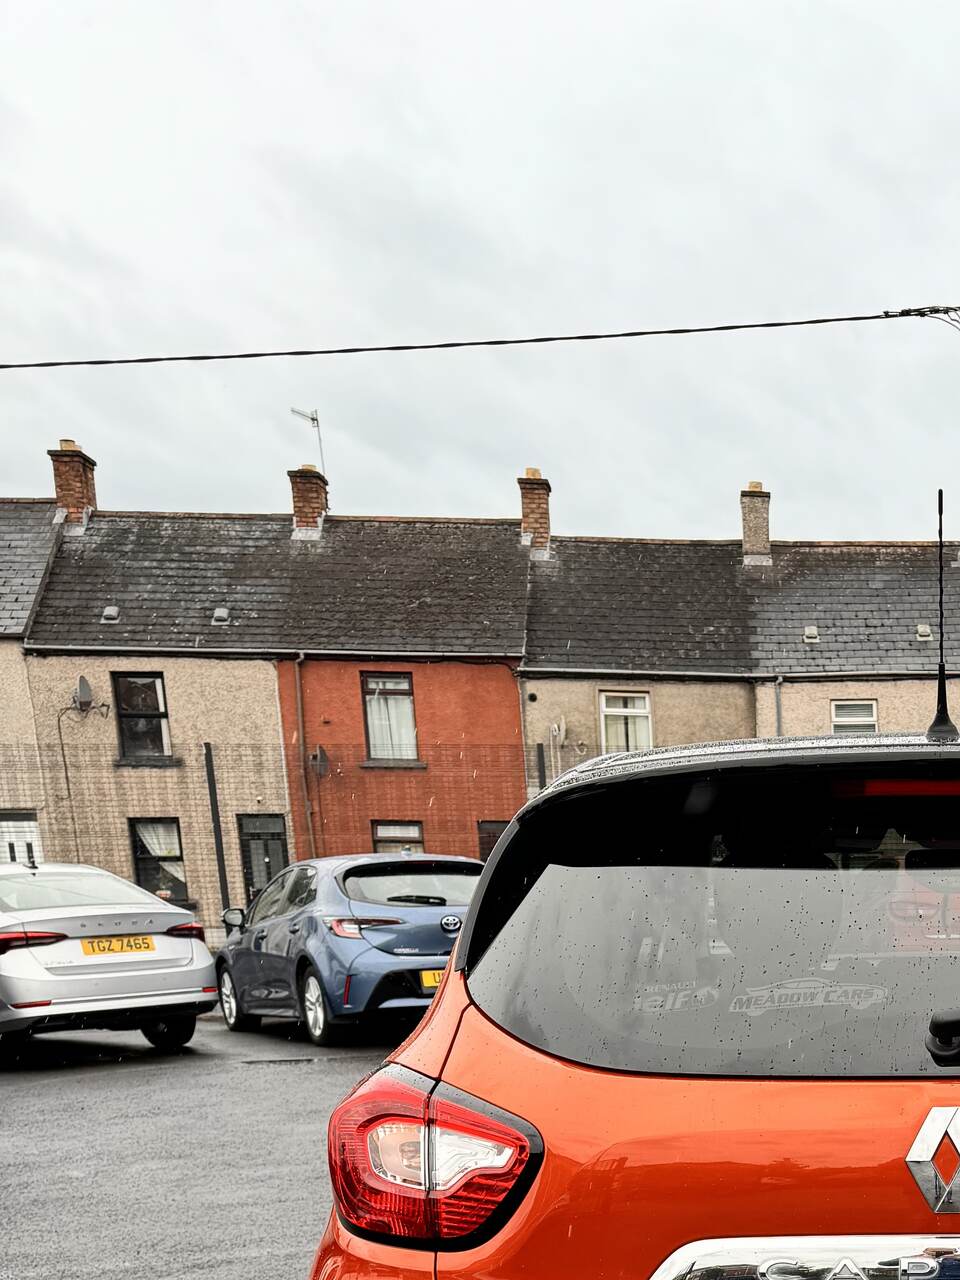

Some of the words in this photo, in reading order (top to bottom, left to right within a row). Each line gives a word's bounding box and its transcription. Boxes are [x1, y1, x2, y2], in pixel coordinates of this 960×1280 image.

[88, 940, 115, 953] TGZ
[116, 938, 150, 951] 7465
[735, 991, 818, 1010] MEADOW
[823, 989, 874, 1003] CARS
